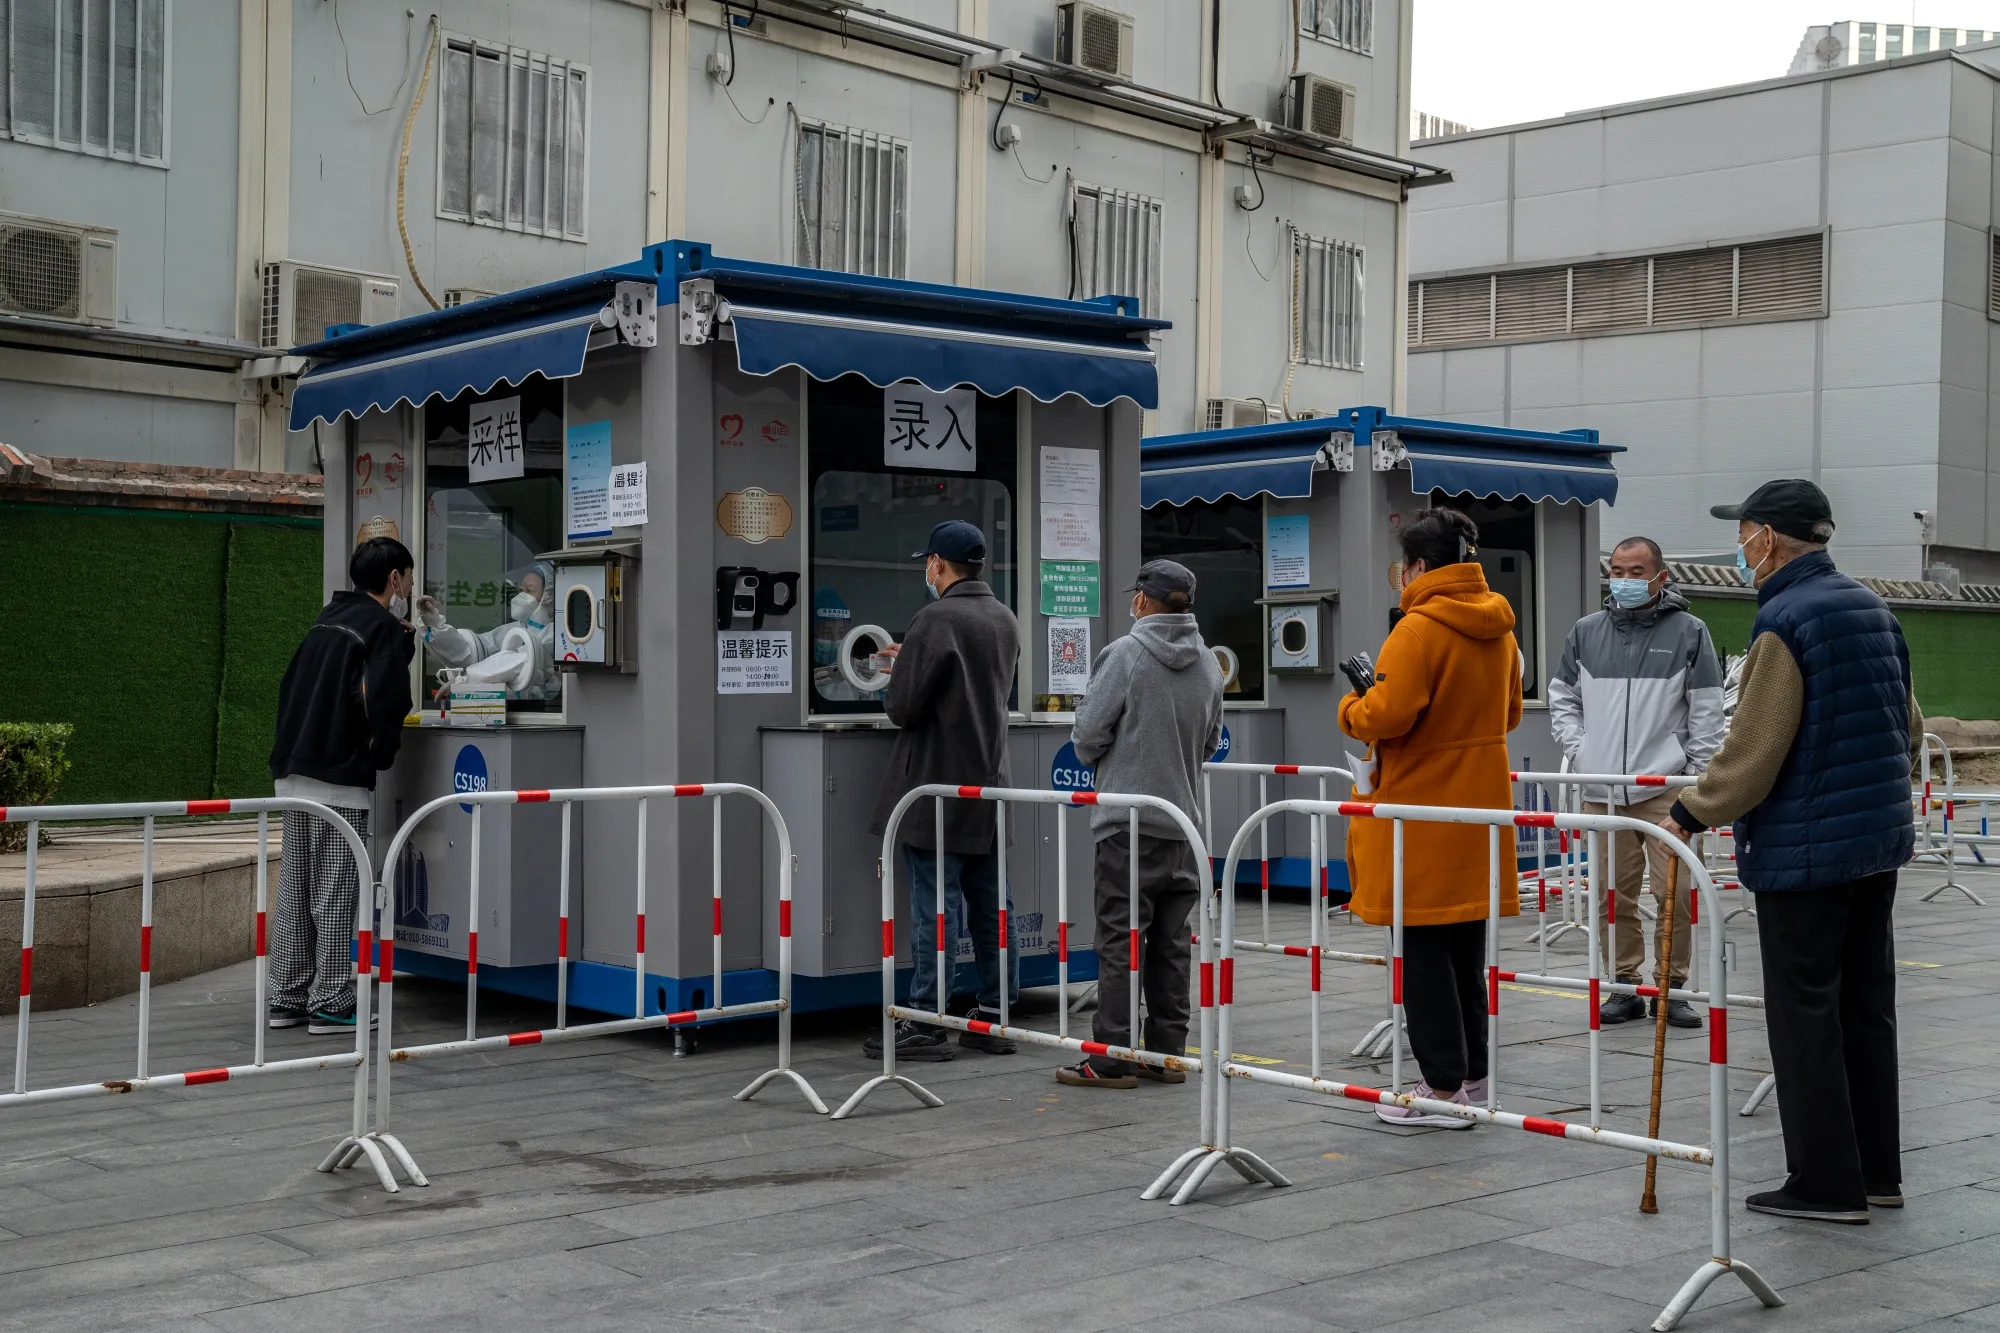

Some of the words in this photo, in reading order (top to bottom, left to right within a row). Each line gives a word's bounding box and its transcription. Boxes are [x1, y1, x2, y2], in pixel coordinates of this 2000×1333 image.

[889, 399, 972, 452] 录入
[471, 410, 521, 466] 采样
[722, 639, 788, 659] 温馨提示
[454, 771, 487, 792] CS198
[1019, 936, 1043, 949] 3118
